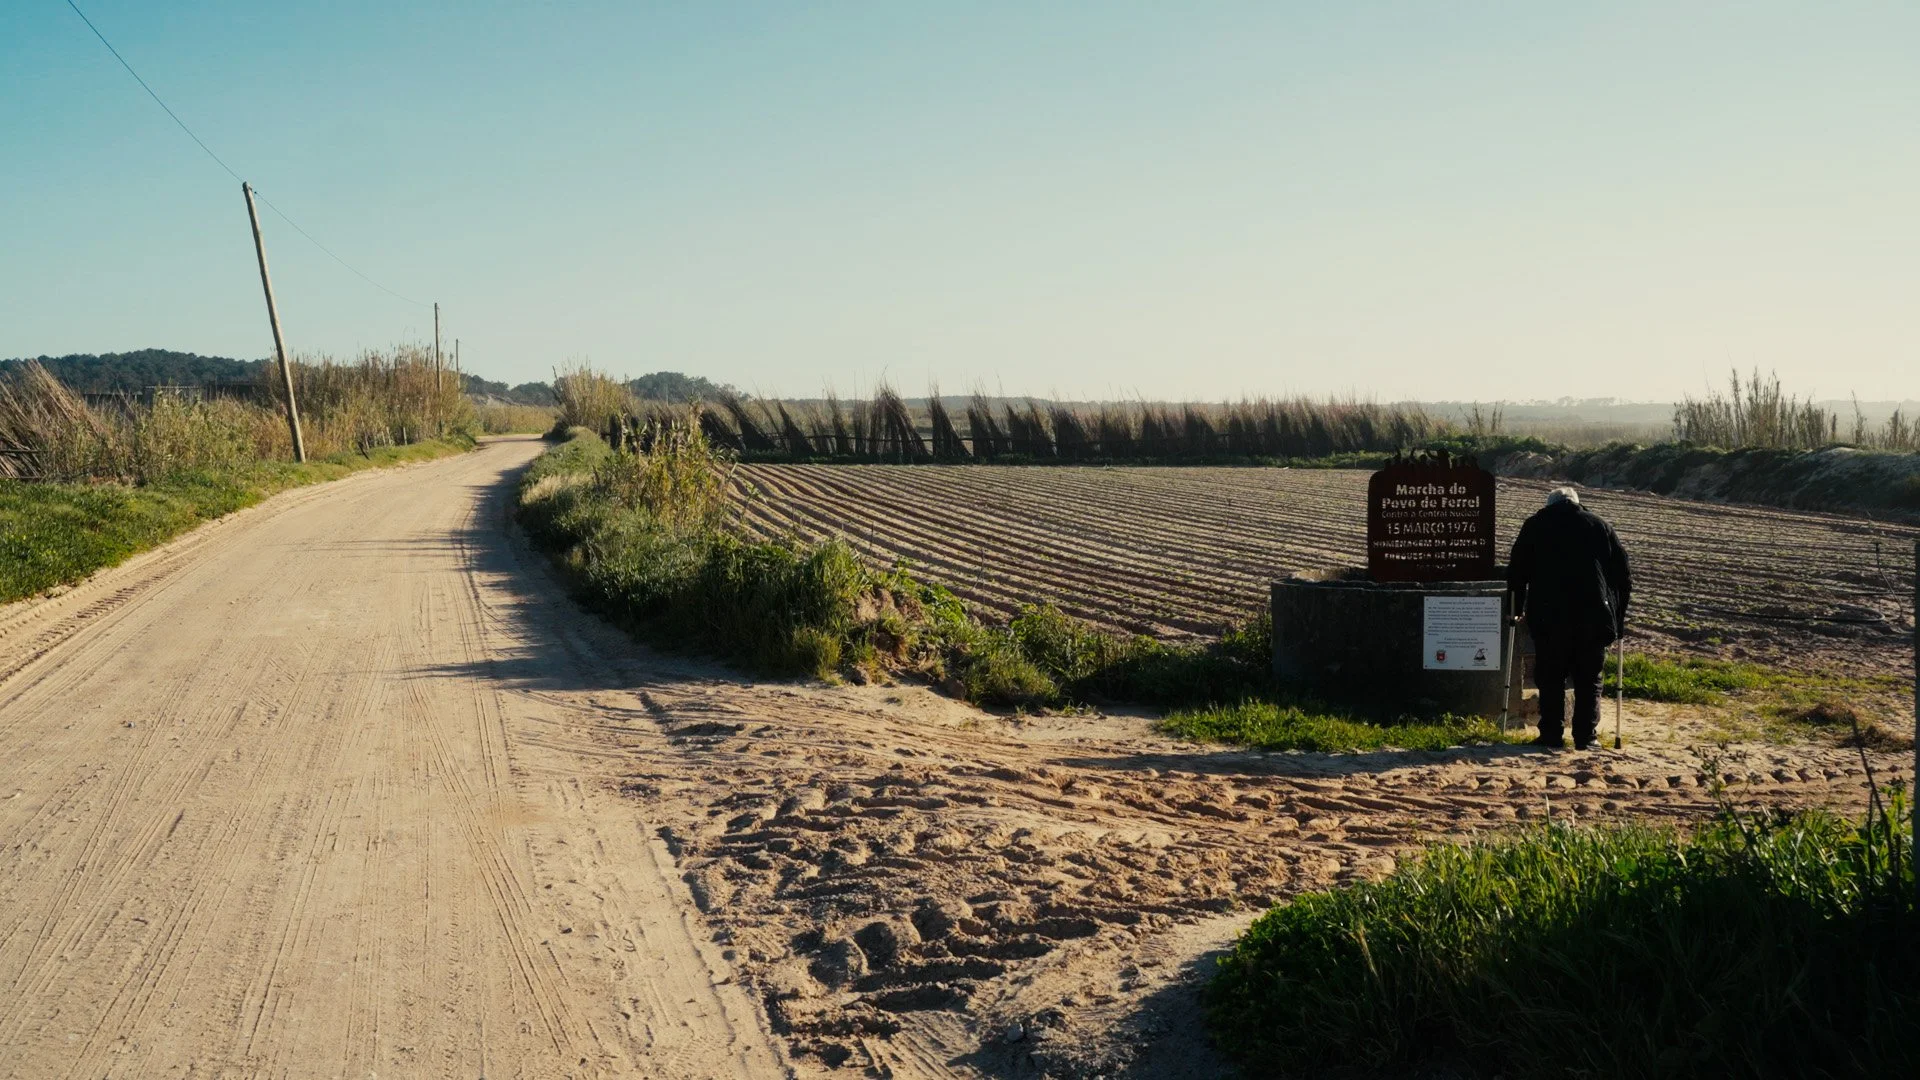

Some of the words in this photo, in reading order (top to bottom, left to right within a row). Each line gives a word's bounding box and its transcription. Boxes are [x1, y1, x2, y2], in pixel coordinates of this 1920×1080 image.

[1396, 483, 1445, 496] Marcha
[1449, 482, 1467, 495] do
[1382, 497, 1416, 509] Povo
[1420, 496, 1437, 508] de
[1441, 495, 1480, 508] Ferrel
[1418, 510, 1447, 518] Central
[1387, 522, 1400, 535] 15
[1403, 522, 1445, 536] MARÇO
[1447, 521, 1476, 533] 1976
[1434, 539, 1447, 547] DA
[1449, 538, 1478, 547] JUNTA
